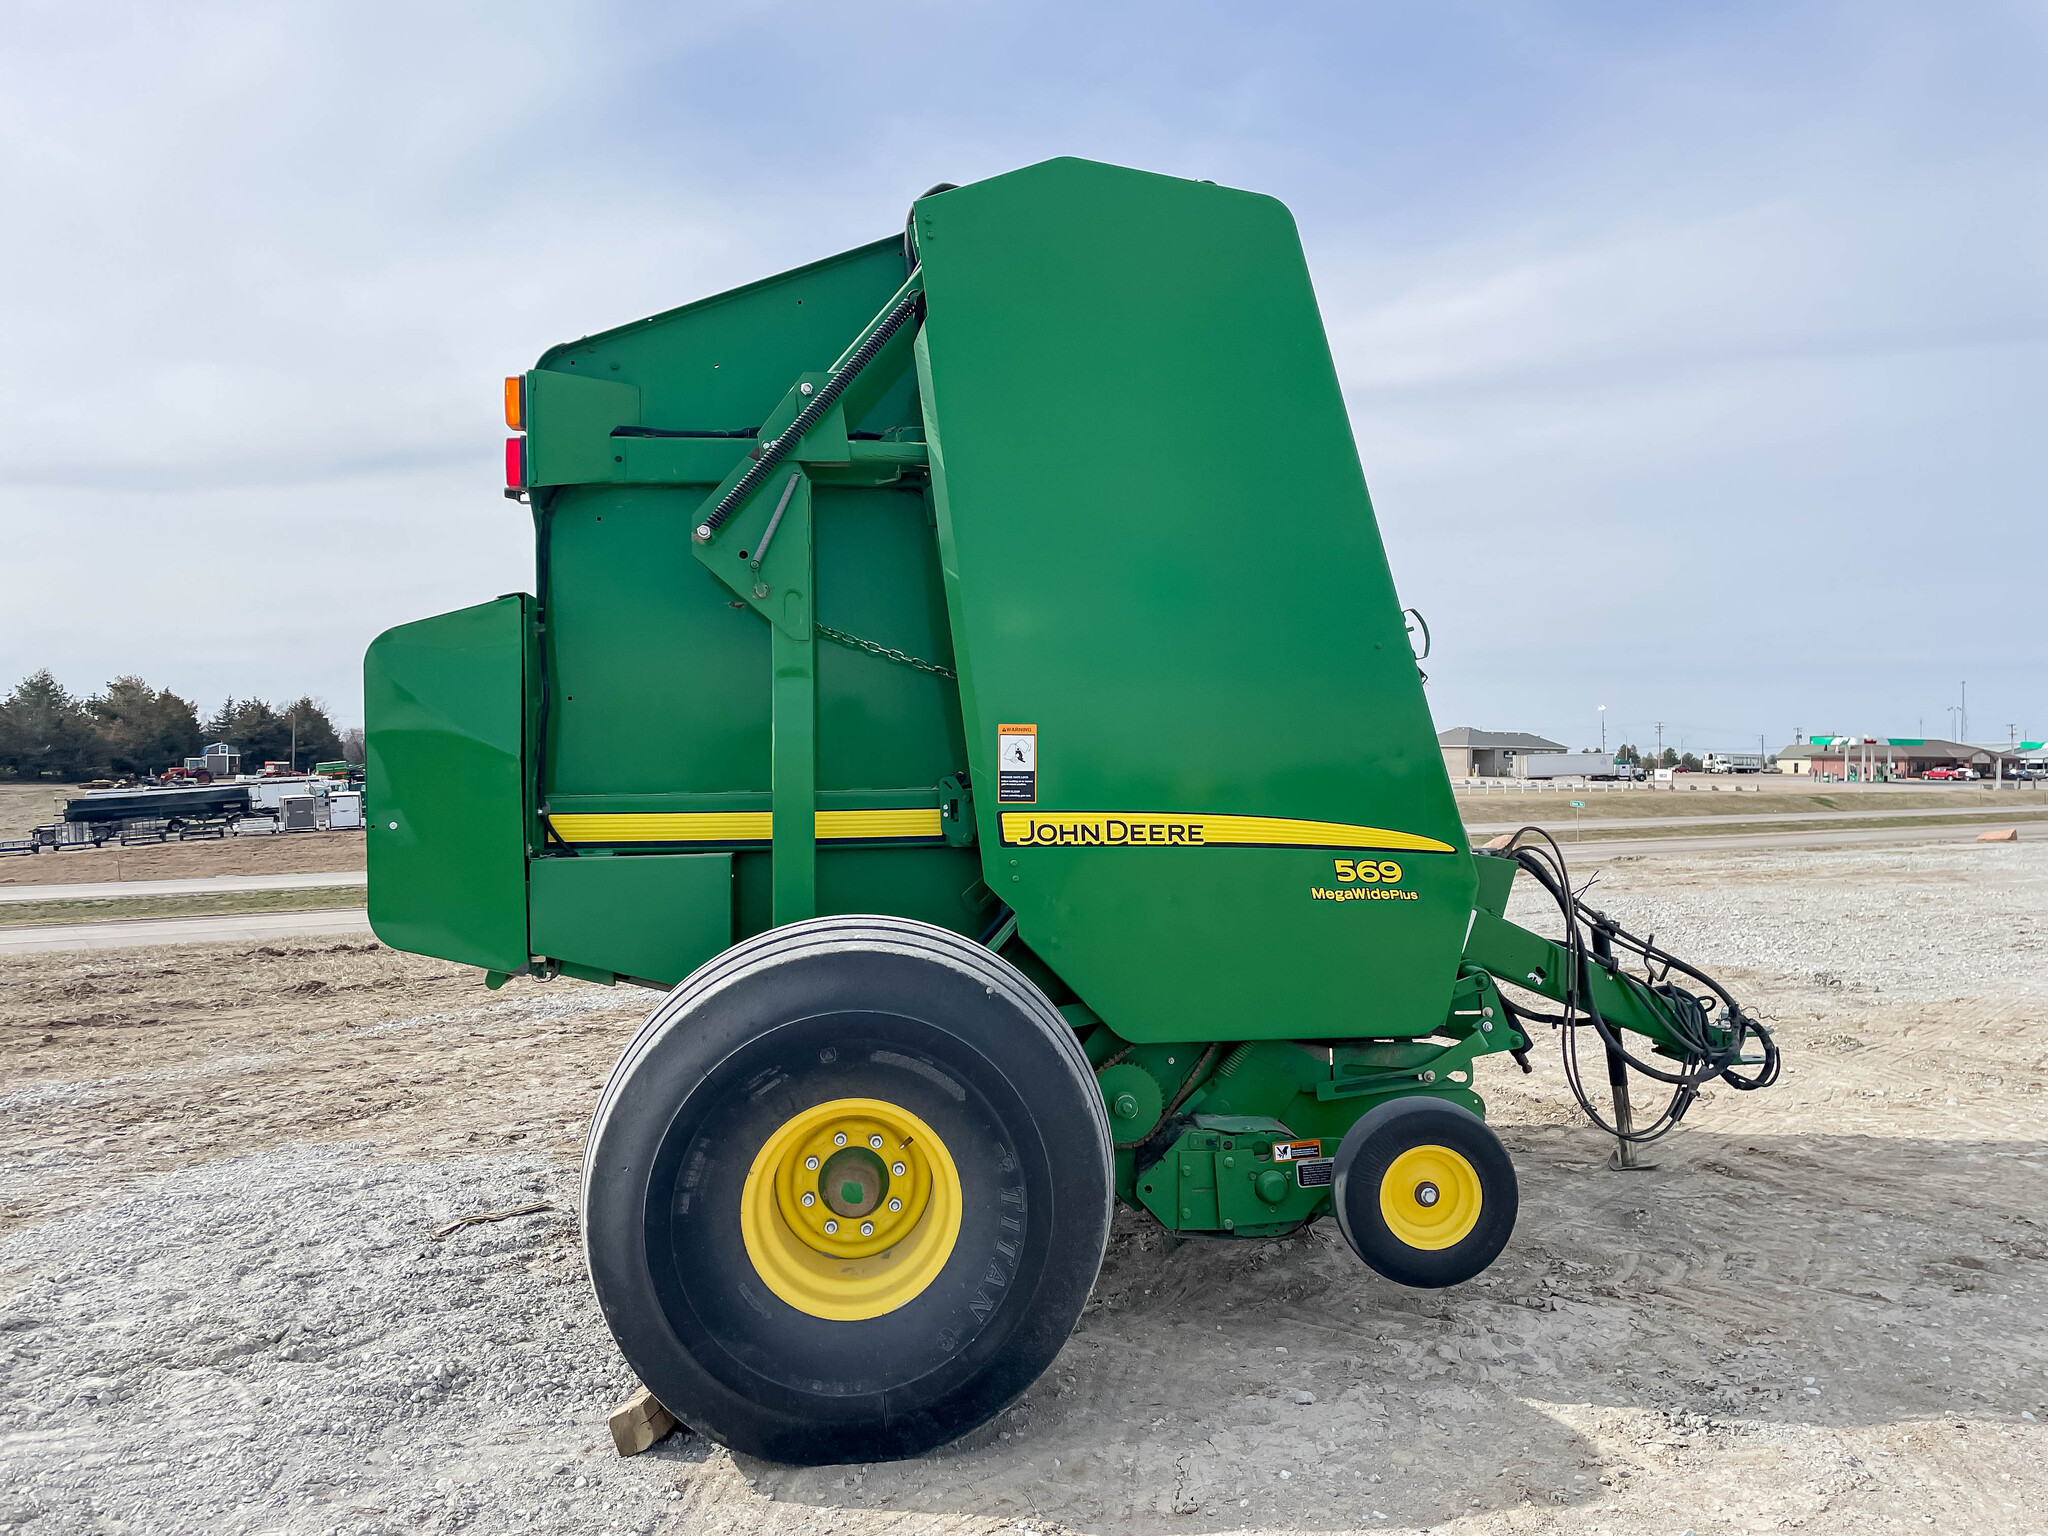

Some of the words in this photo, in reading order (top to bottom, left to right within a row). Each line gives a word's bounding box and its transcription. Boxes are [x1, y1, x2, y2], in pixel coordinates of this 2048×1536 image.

[1019, 820, 1099, 842] JOHN
[1106, 820, 1204, 842] DEERE
[1334, 859, 1402, 883] 569
[1311, 887, 1418, 902] MegaWidePlus
[968, 1186, 1026, 1325] TITAN
